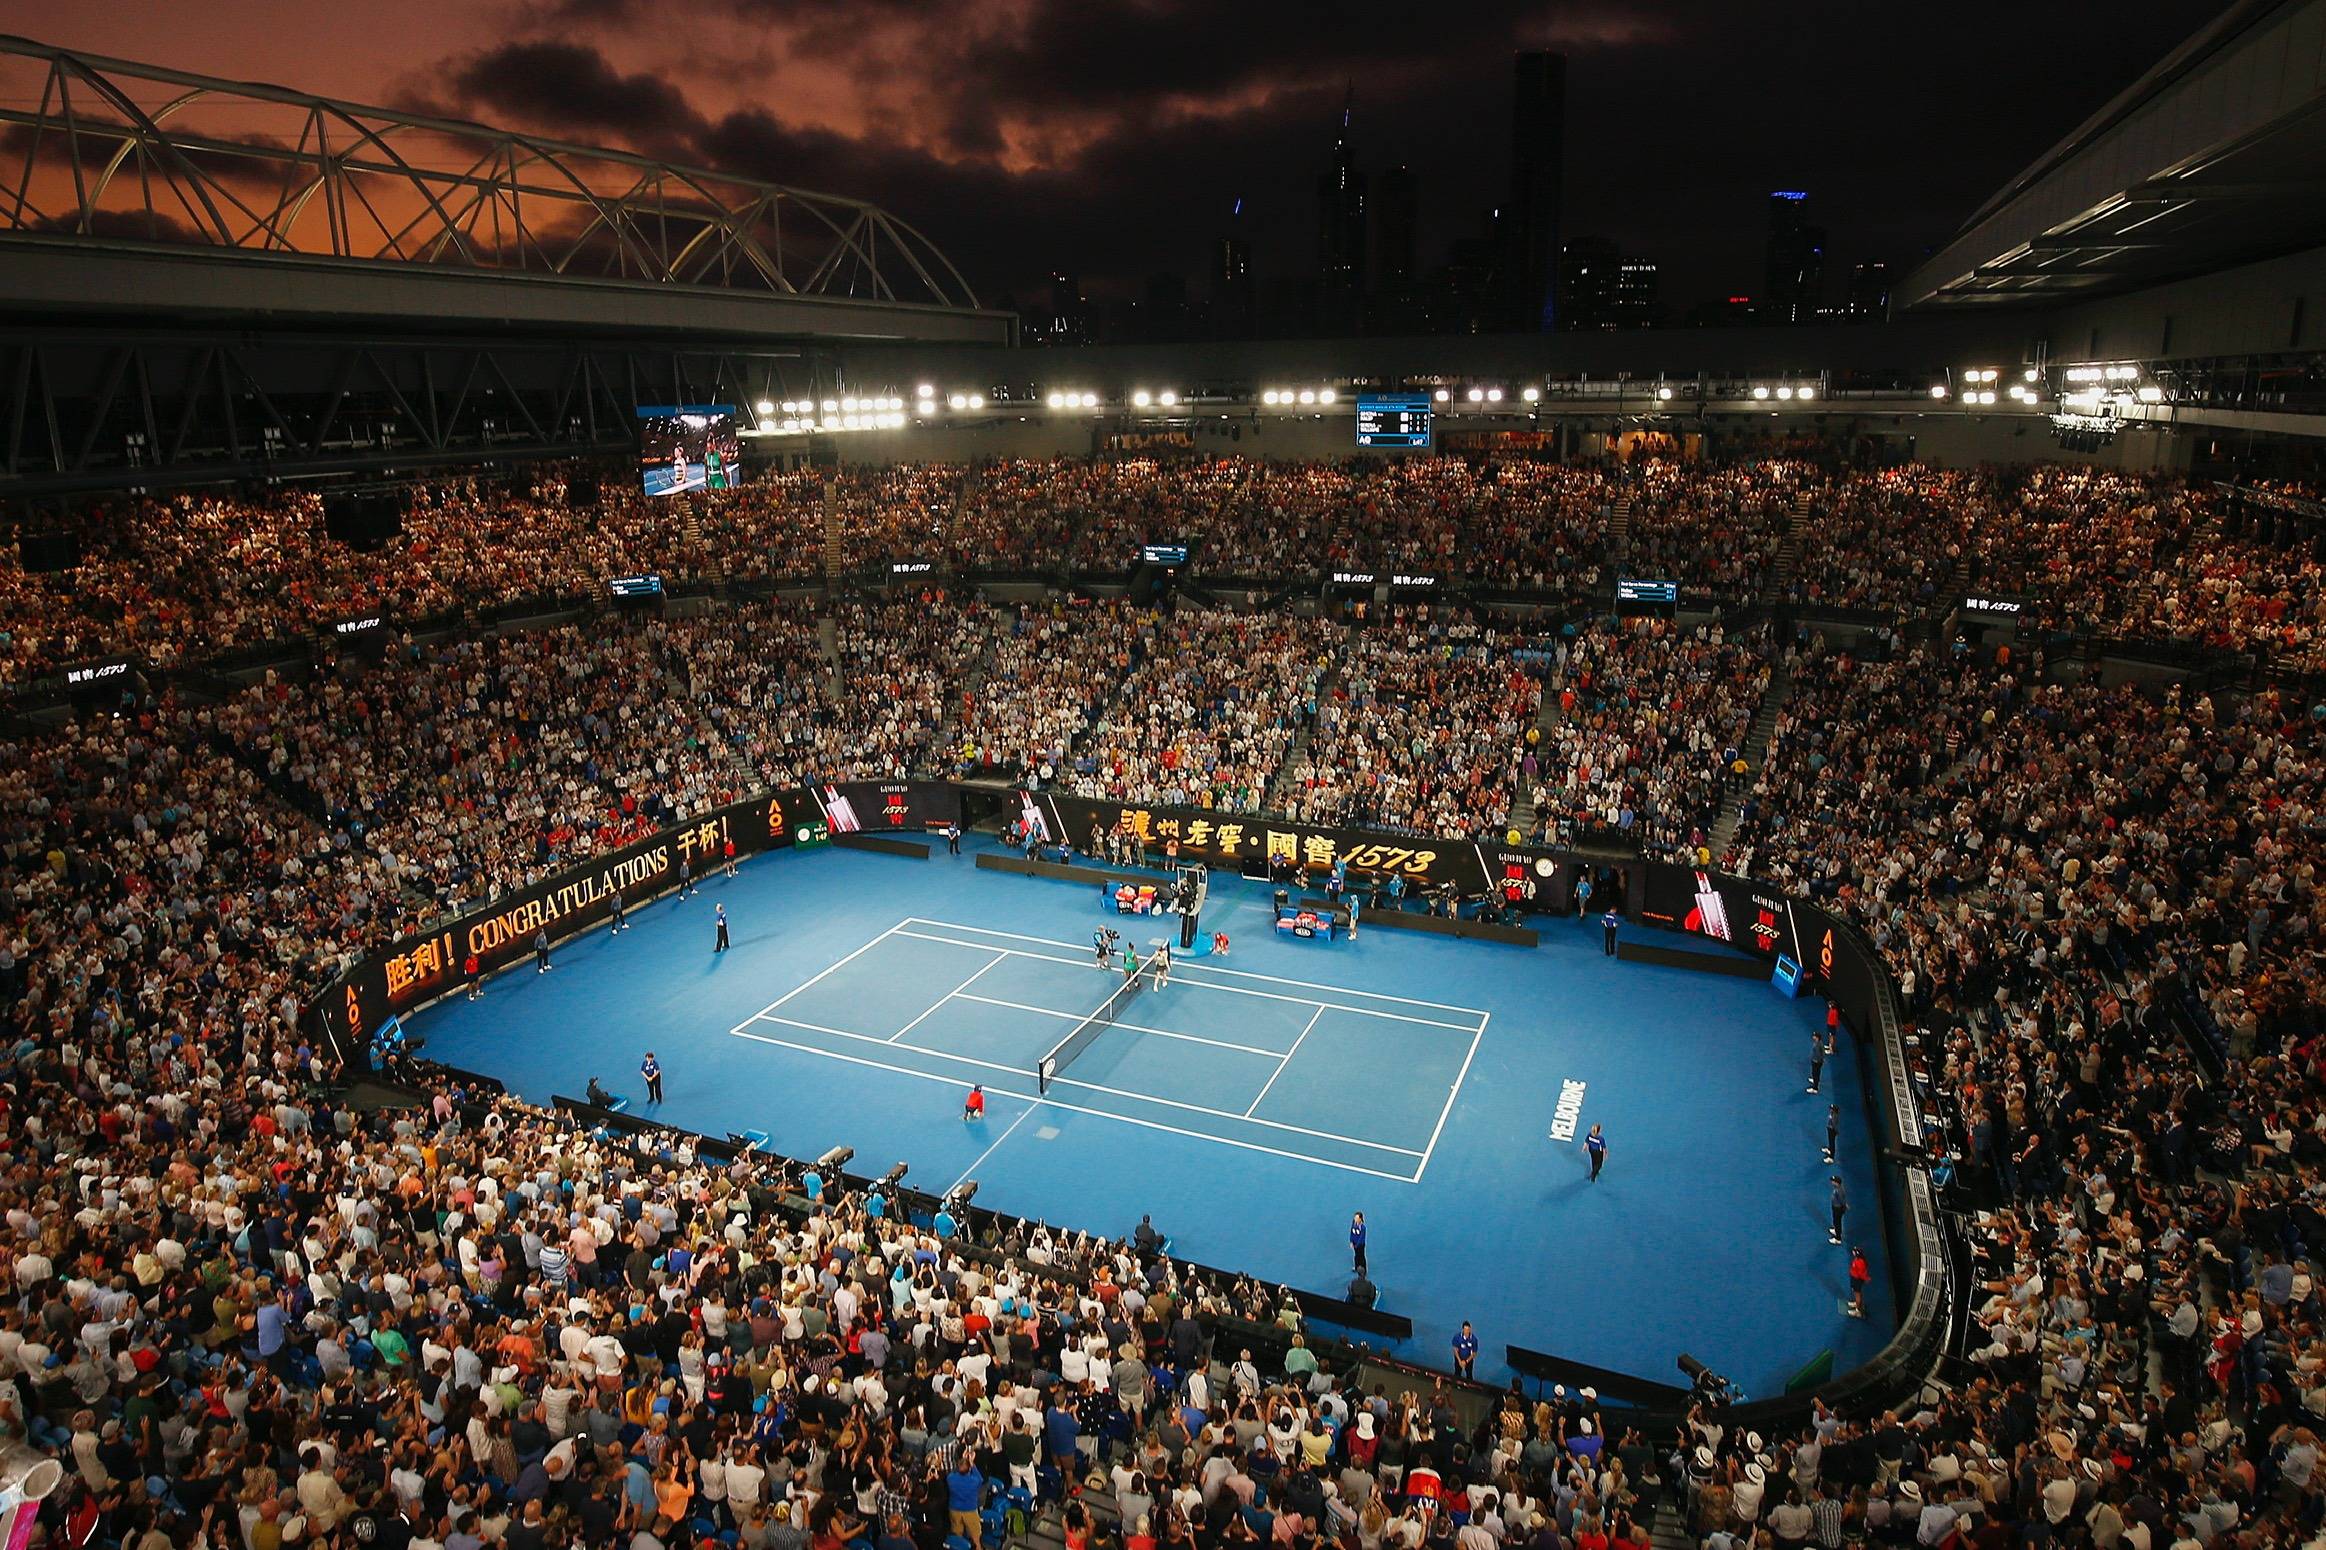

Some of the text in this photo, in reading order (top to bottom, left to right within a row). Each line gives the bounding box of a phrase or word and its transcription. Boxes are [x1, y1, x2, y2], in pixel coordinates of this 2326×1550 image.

[469, 846, 668, 954] CONGRATULATIONS
[1750, 922, 1781, 939] 1573
[1549, 1078, 1587, 1143] MELBOURNE
